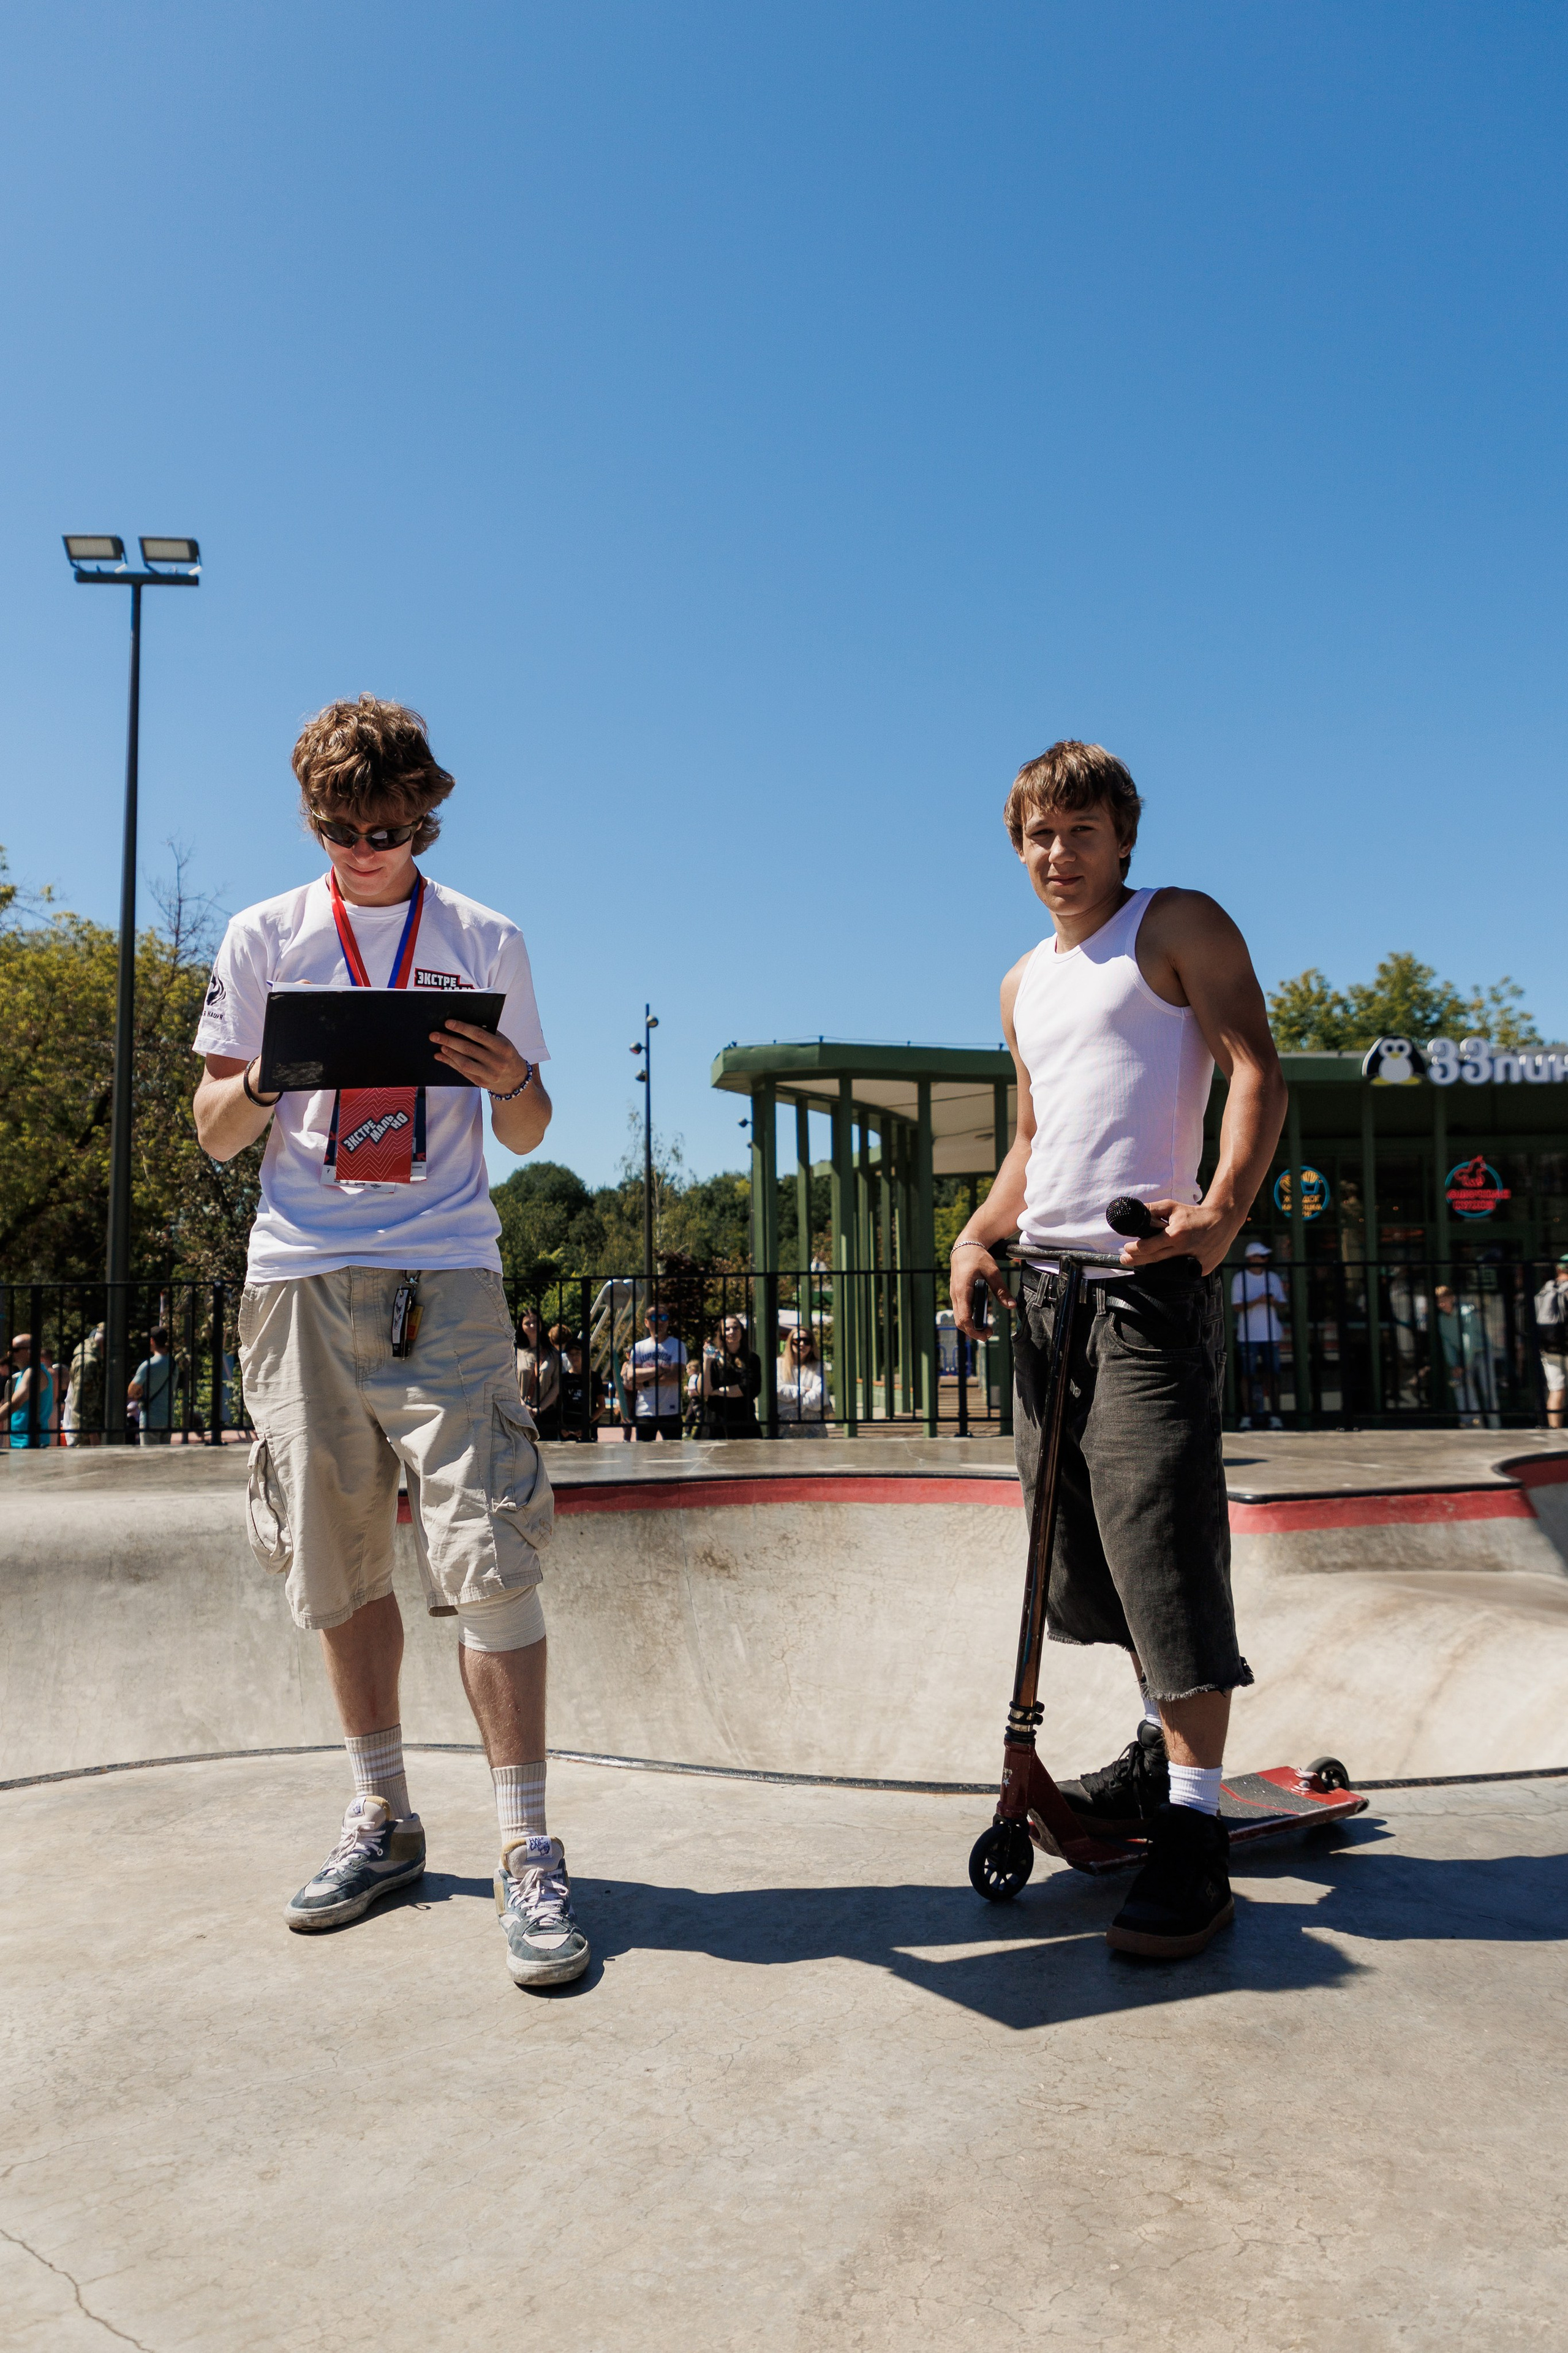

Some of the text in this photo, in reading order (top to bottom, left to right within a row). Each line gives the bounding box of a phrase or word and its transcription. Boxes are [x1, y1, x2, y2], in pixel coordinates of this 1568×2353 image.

[418, 972, 457, 987] ЭКСТРЕ
[369, 1115, 394, 1143] МАЛЬ
[390, 1112, 409, 1130] НО
[343, 1120, 377, 1152] ЭКСТРЕ
